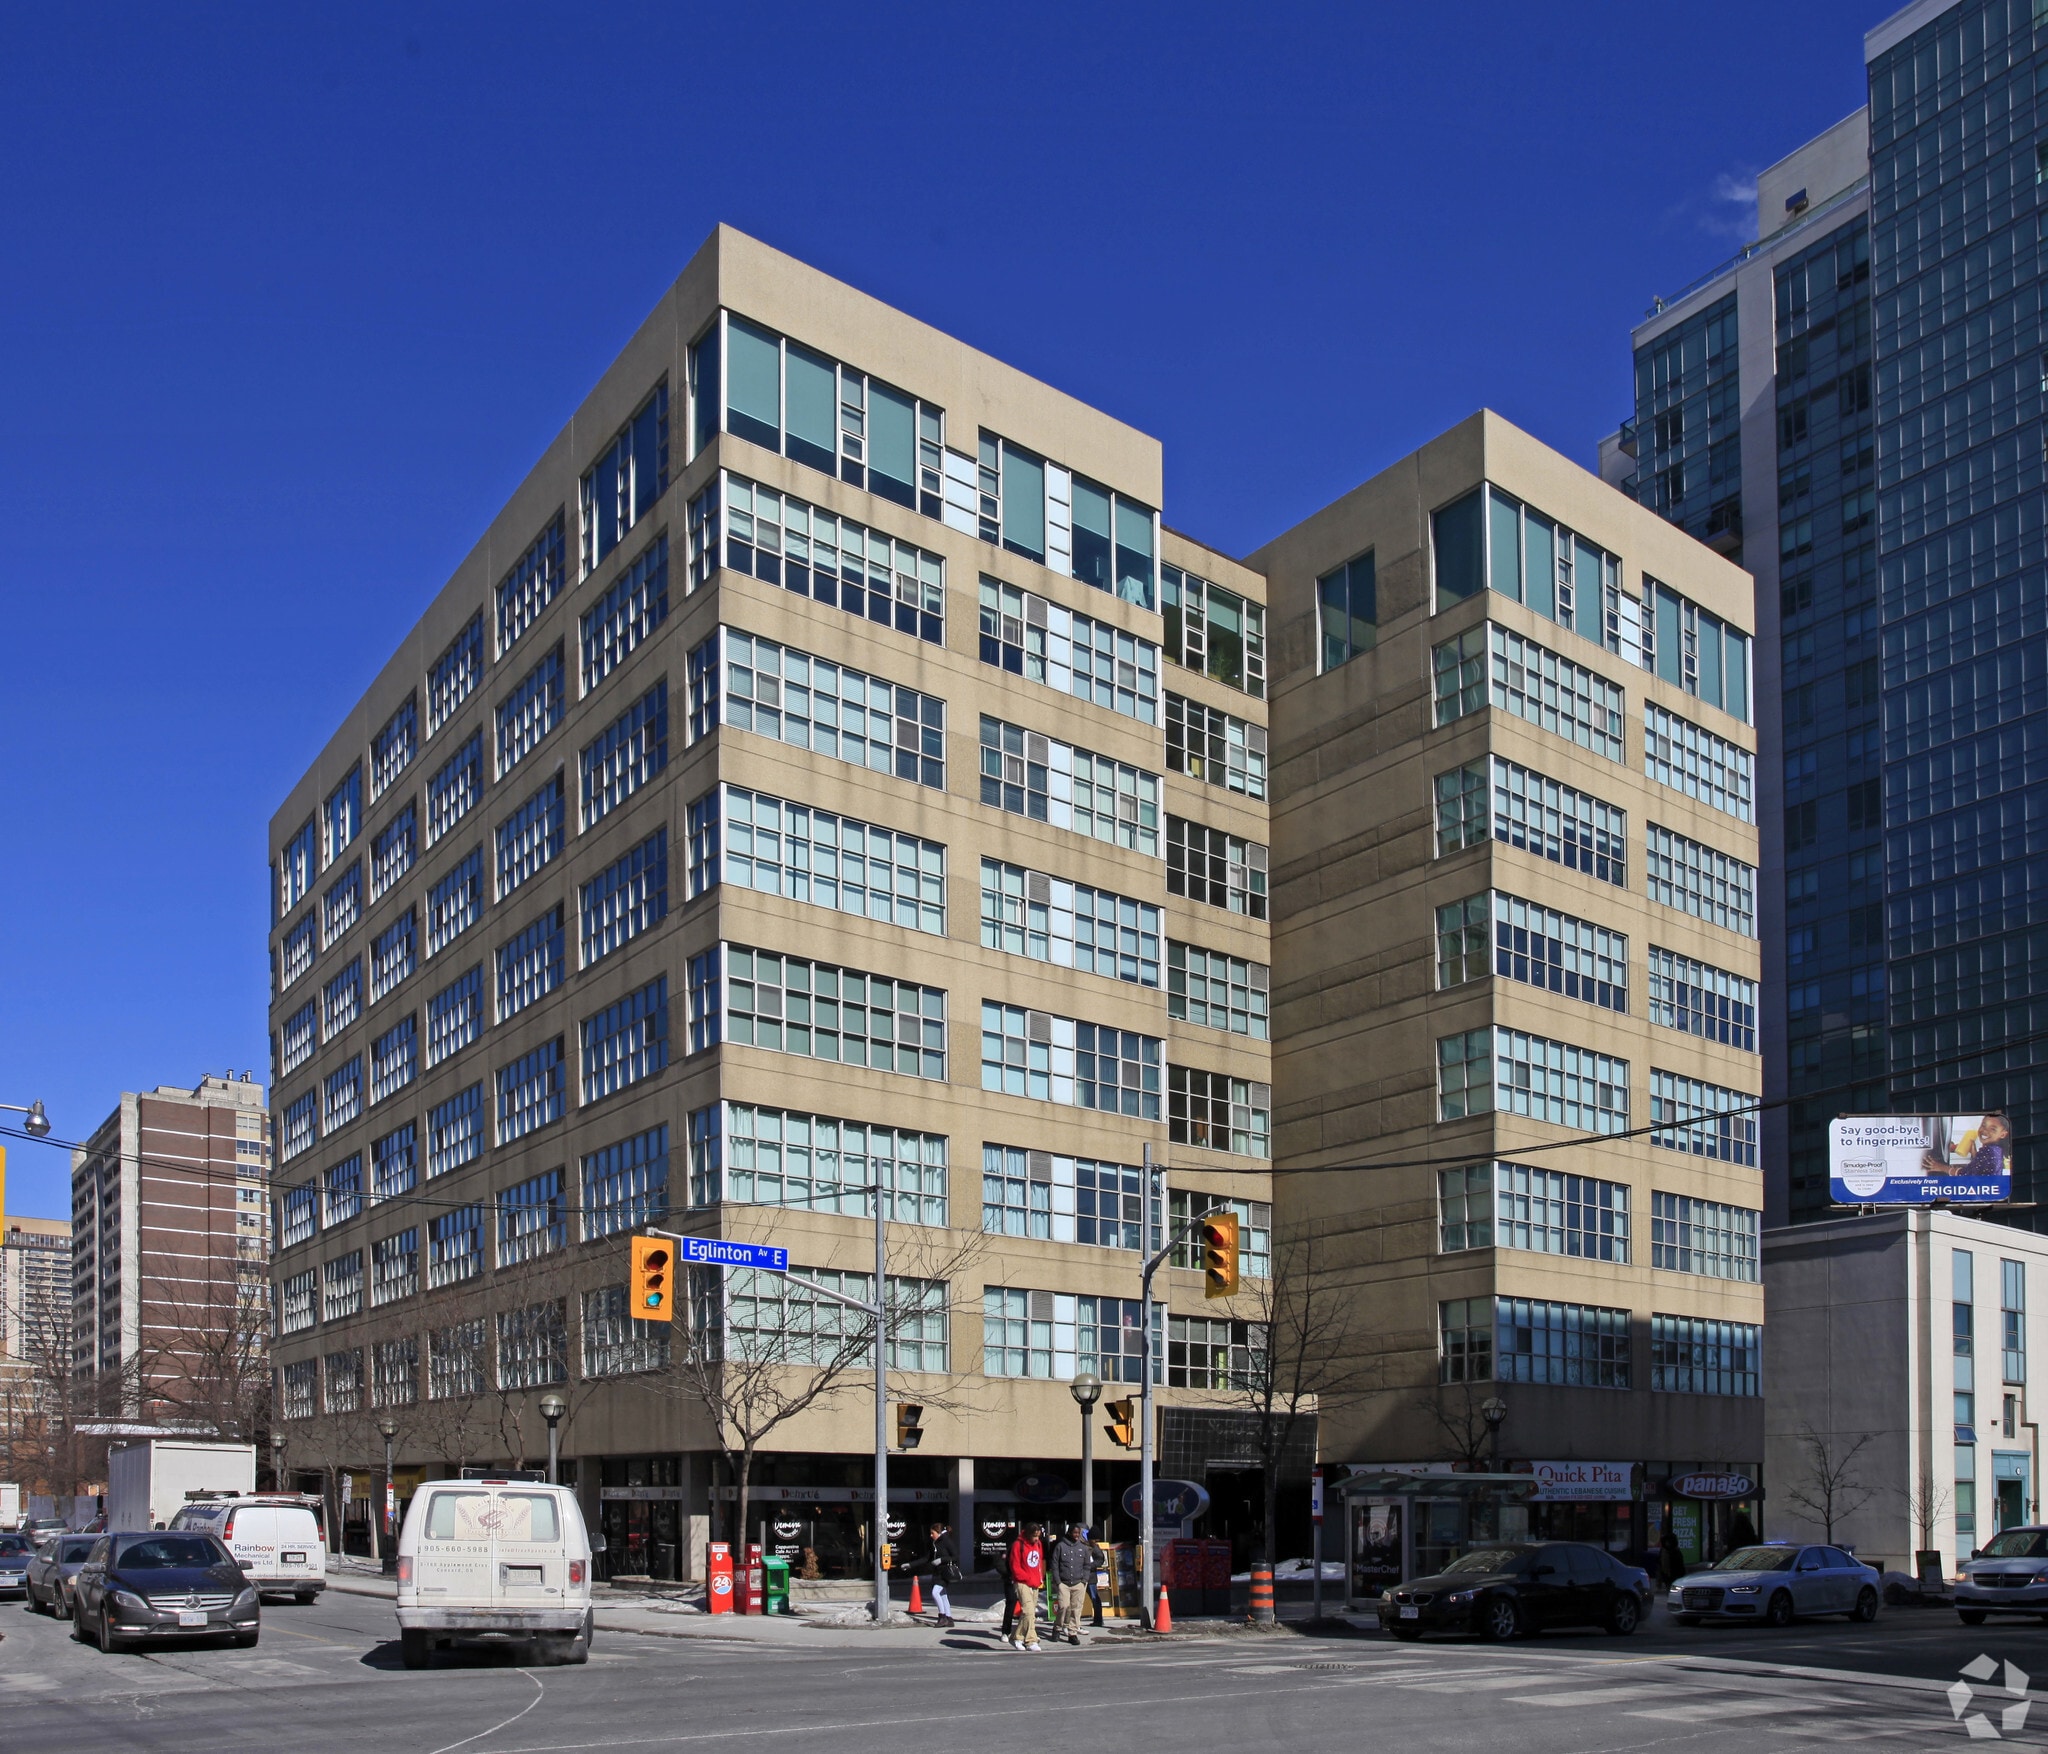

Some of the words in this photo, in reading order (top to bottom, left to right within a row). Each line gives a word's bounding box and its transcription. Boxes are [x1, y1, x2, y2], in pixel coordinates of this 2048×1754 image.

[1840, 1125, 1861, 1137] Say
[1864, 1124, 1920, 1137] good-bye
[1840, 1138, 1853, 1146] to
[1856, 1136, 1930, 1148] fingerprints!
[1890, 1178, 1921, 1186] Exclusively
[1921, 1185, 2000, 1196] FRIGIDAIRE
[689, 1241, 752, 1262] Eglinton
[758, 1248, 768, 1257] Av
[774, 1250, 782, 1265] E
[1538, 1465, 1587, 1487] Quick
[1591, 1465, 1622, 1482] Pita
[1682, 1474, 1749, 1495] panago
[1570, 1487, 1603, 1495] LEBANESE
[1604, 1487, 1627, 1495] CUISINE
[1672, 1506, 1688, 1516] GET
[1672, 1517, 1697, 1527] FRESH
[234, 1543, 275, 1552] Rainbow
[1356, 1564, 1400, 1574] MasterChef
[714, 1577, 730, 1588] 24
